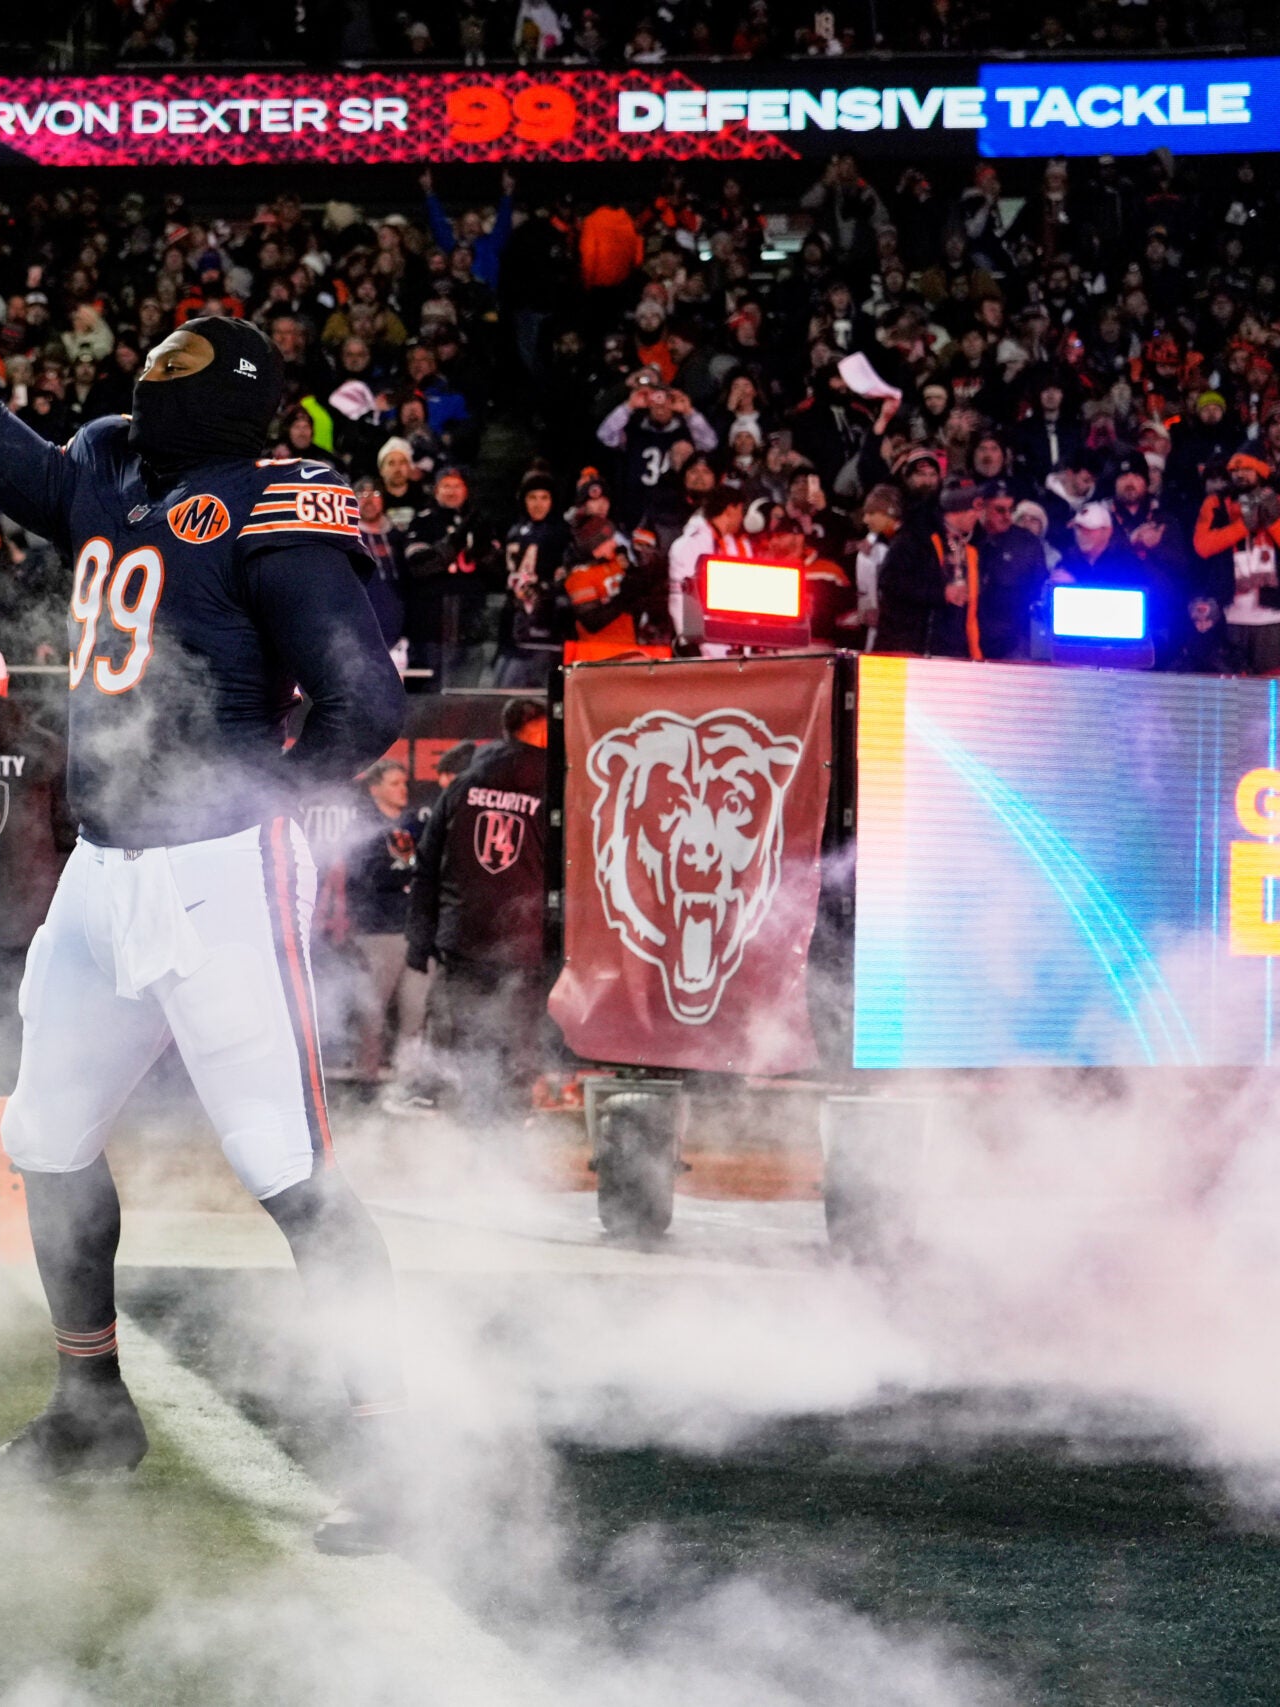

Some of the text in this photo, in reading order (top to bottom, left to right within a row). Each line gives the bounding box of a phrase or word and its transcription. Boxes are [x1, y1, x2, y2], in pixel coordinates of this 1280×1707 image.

[132, 98, 328, 135] DEXTER
[338, 97, 409, 133] SR
[447, 86, 577, 142] 99
[618, 87, 987, 132] DEFENSIVE
[995, 83, 1251, 128] TACKLE
[296, 491, 349, 526] GSH
[70, 535, 165, 695] 99
[467, 787, 541, 817] SECURITY
[483, 811, 515, 867] P4
